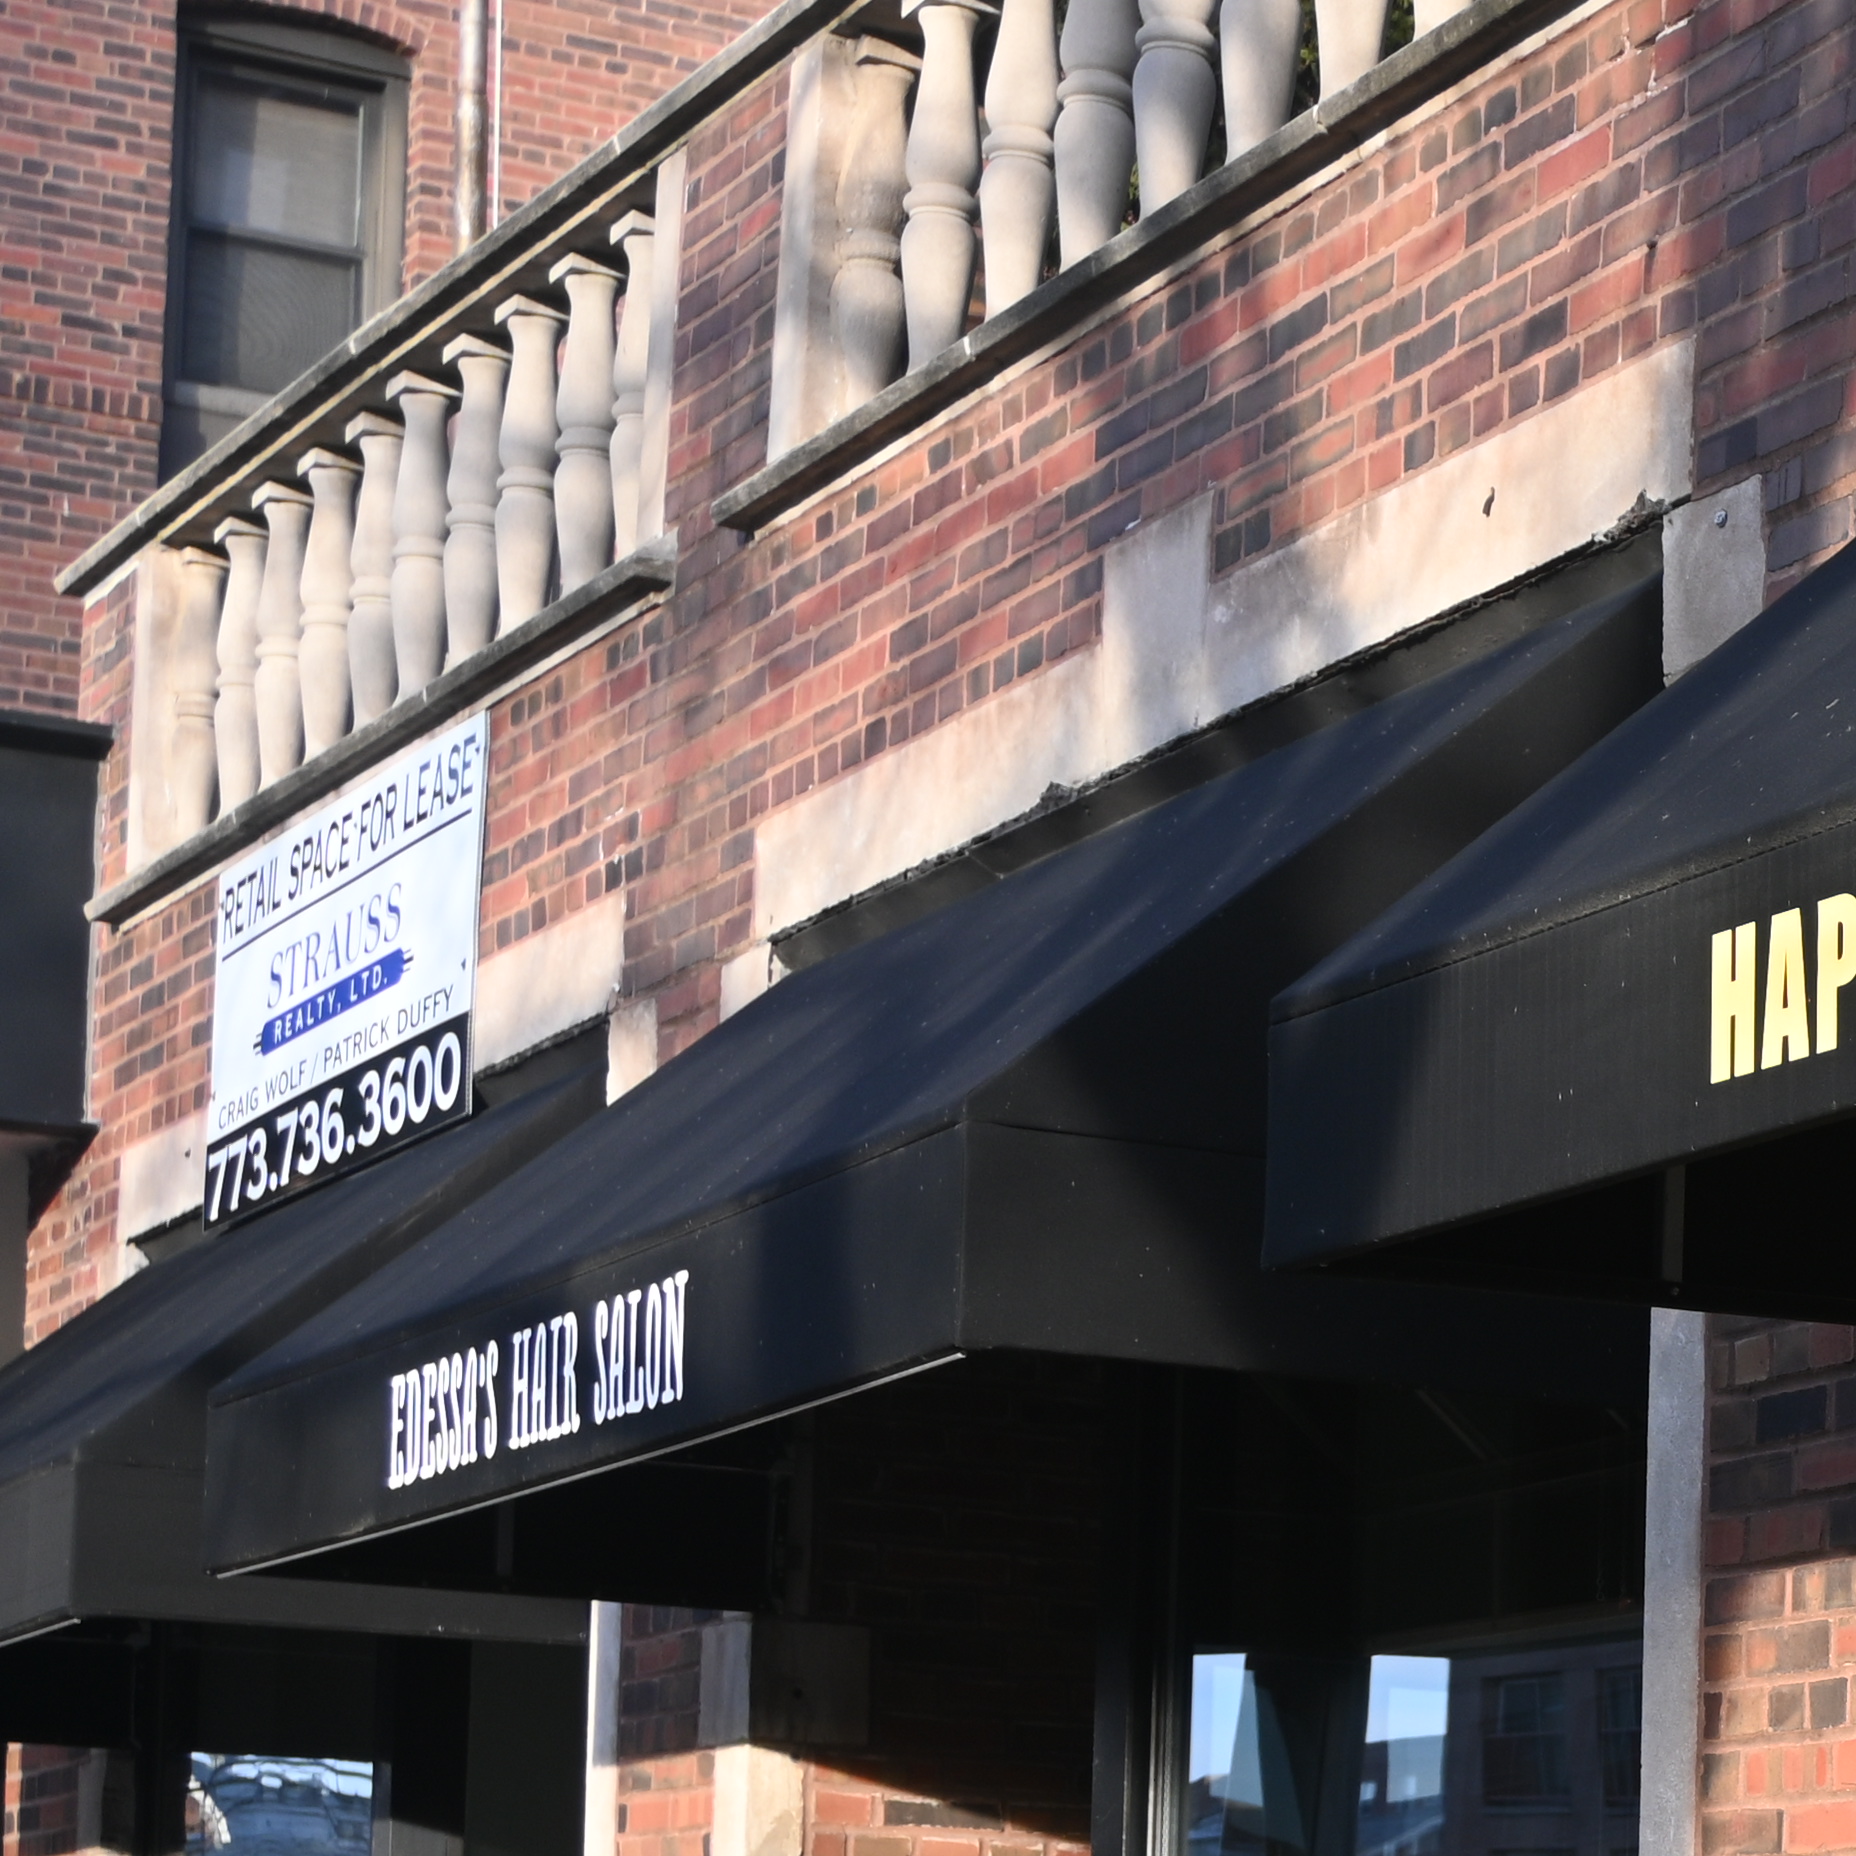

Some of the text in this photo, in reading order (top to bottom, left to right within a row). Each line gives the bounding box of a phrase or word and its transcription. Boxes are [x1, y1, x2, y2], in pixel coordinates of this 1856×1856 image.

[223, 733, 476, 943] RETAIL SPACE FOR LEASE
[266, 882, 401, 1009] STRAUSS
[273, 965, 388, 1044] REALTY, LTD.
[208, 1032, 461, 1221] 773.736.3600
[218, 1087, 259, 1129] CRAIG
[265, 1059, 307, 1103] WOLF
[324, 1016, 389, 1073] PATRICK
[397, 984, 454, 1034] DUFFY
[388, 1270, 689, 1489] EDESSA'S HAIR SALON
